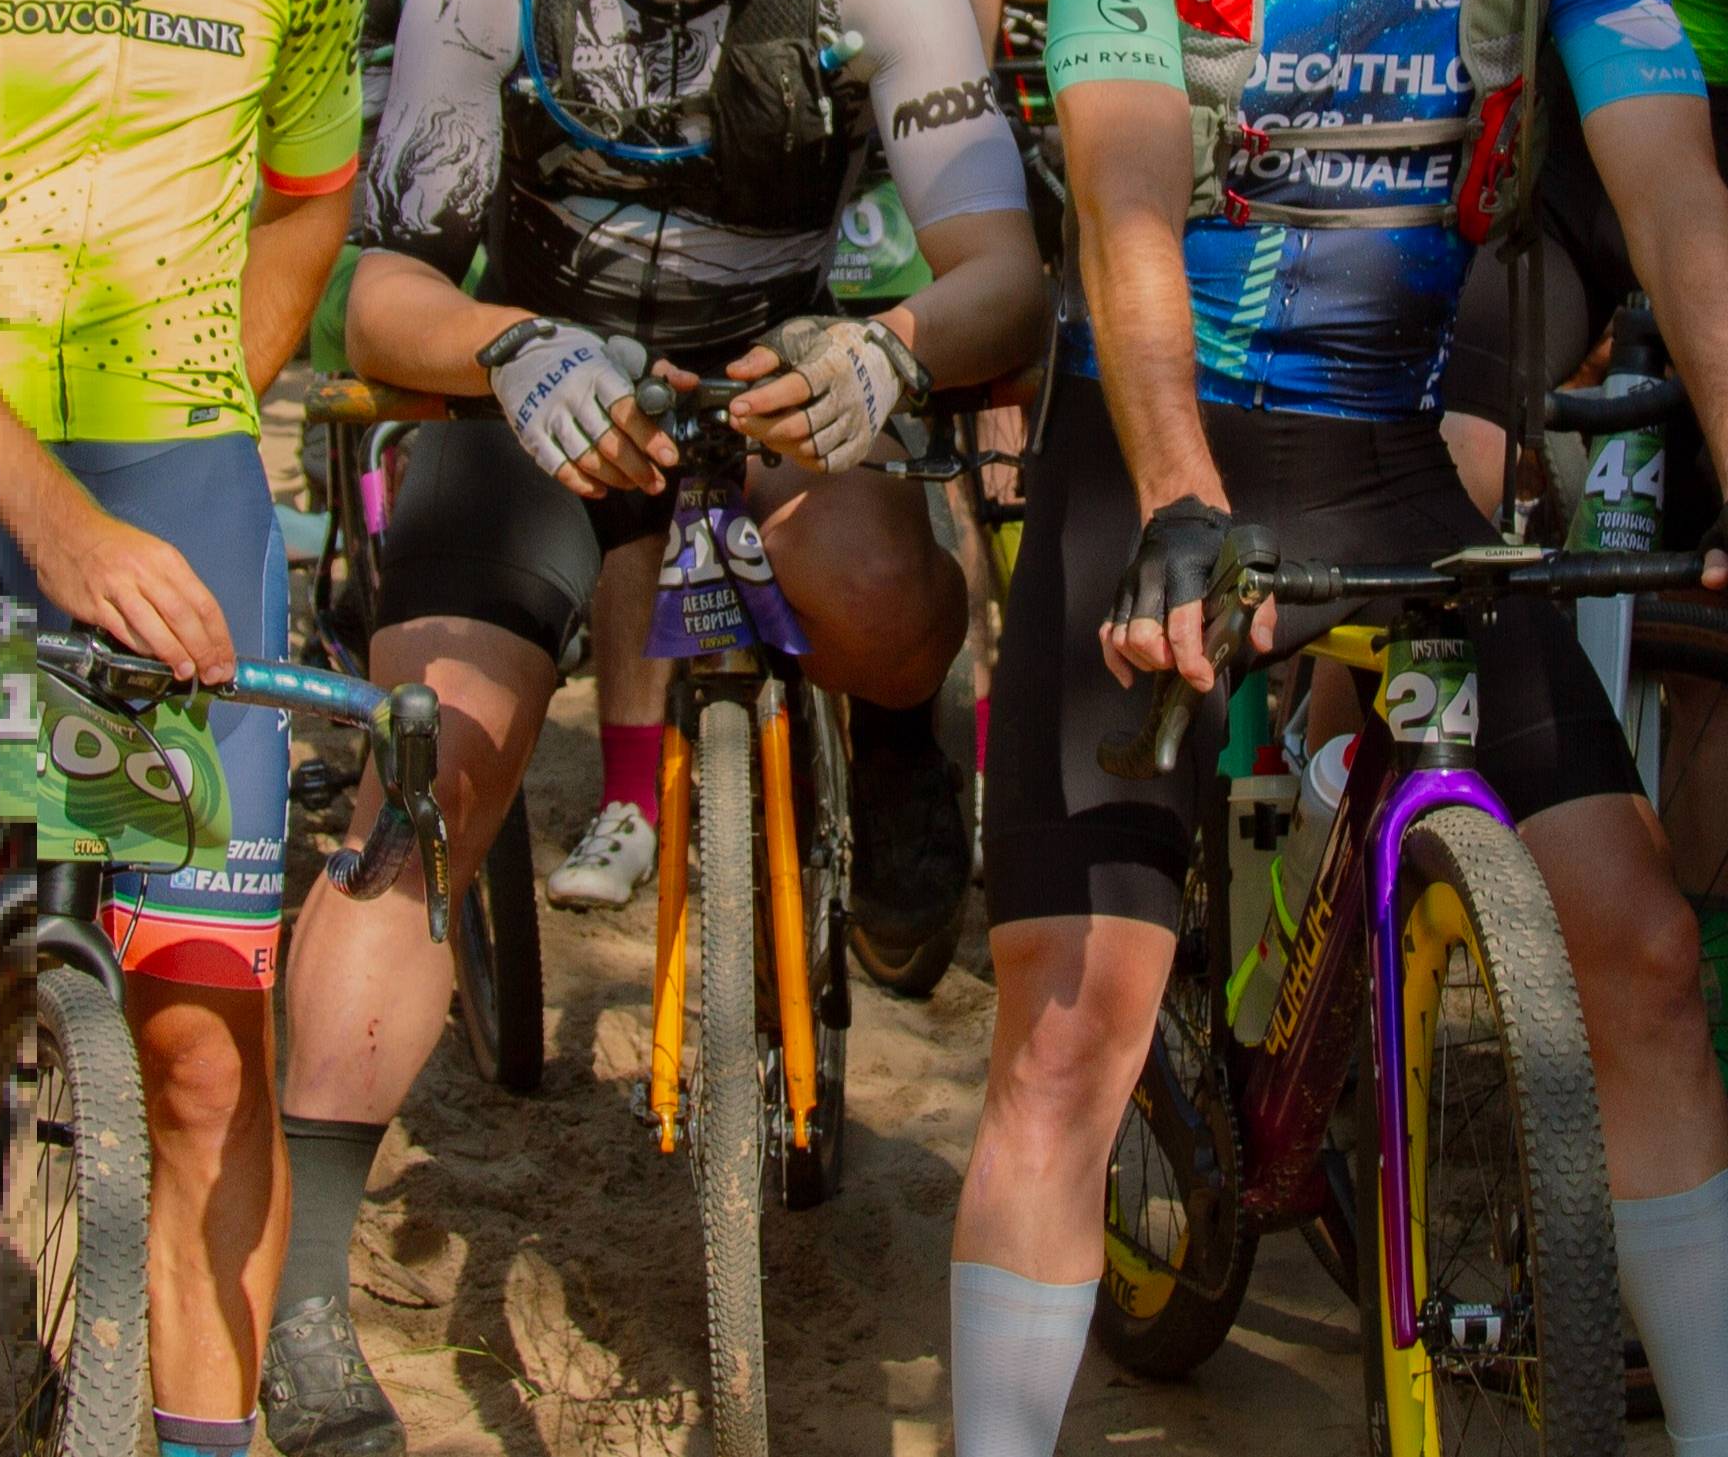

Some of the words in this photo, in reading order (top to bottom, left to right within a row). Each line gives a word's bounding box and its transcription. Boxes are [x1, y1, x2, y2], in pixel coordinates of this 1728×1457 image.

[1053, 52, 1089, 74] VAN
[1100, 51, 1171, 69] RYSEL
[1245, 52, 1473, 95] DECATHLO
[1585, 439, 1666, 512] 44
[1485, 549, 1524, 558] GARMIN
[1410, 638, 1466, 664] INSTINCT
[79, 700, 138, 741] INSTINCT
[1386, 671, 1479, 746] 24
